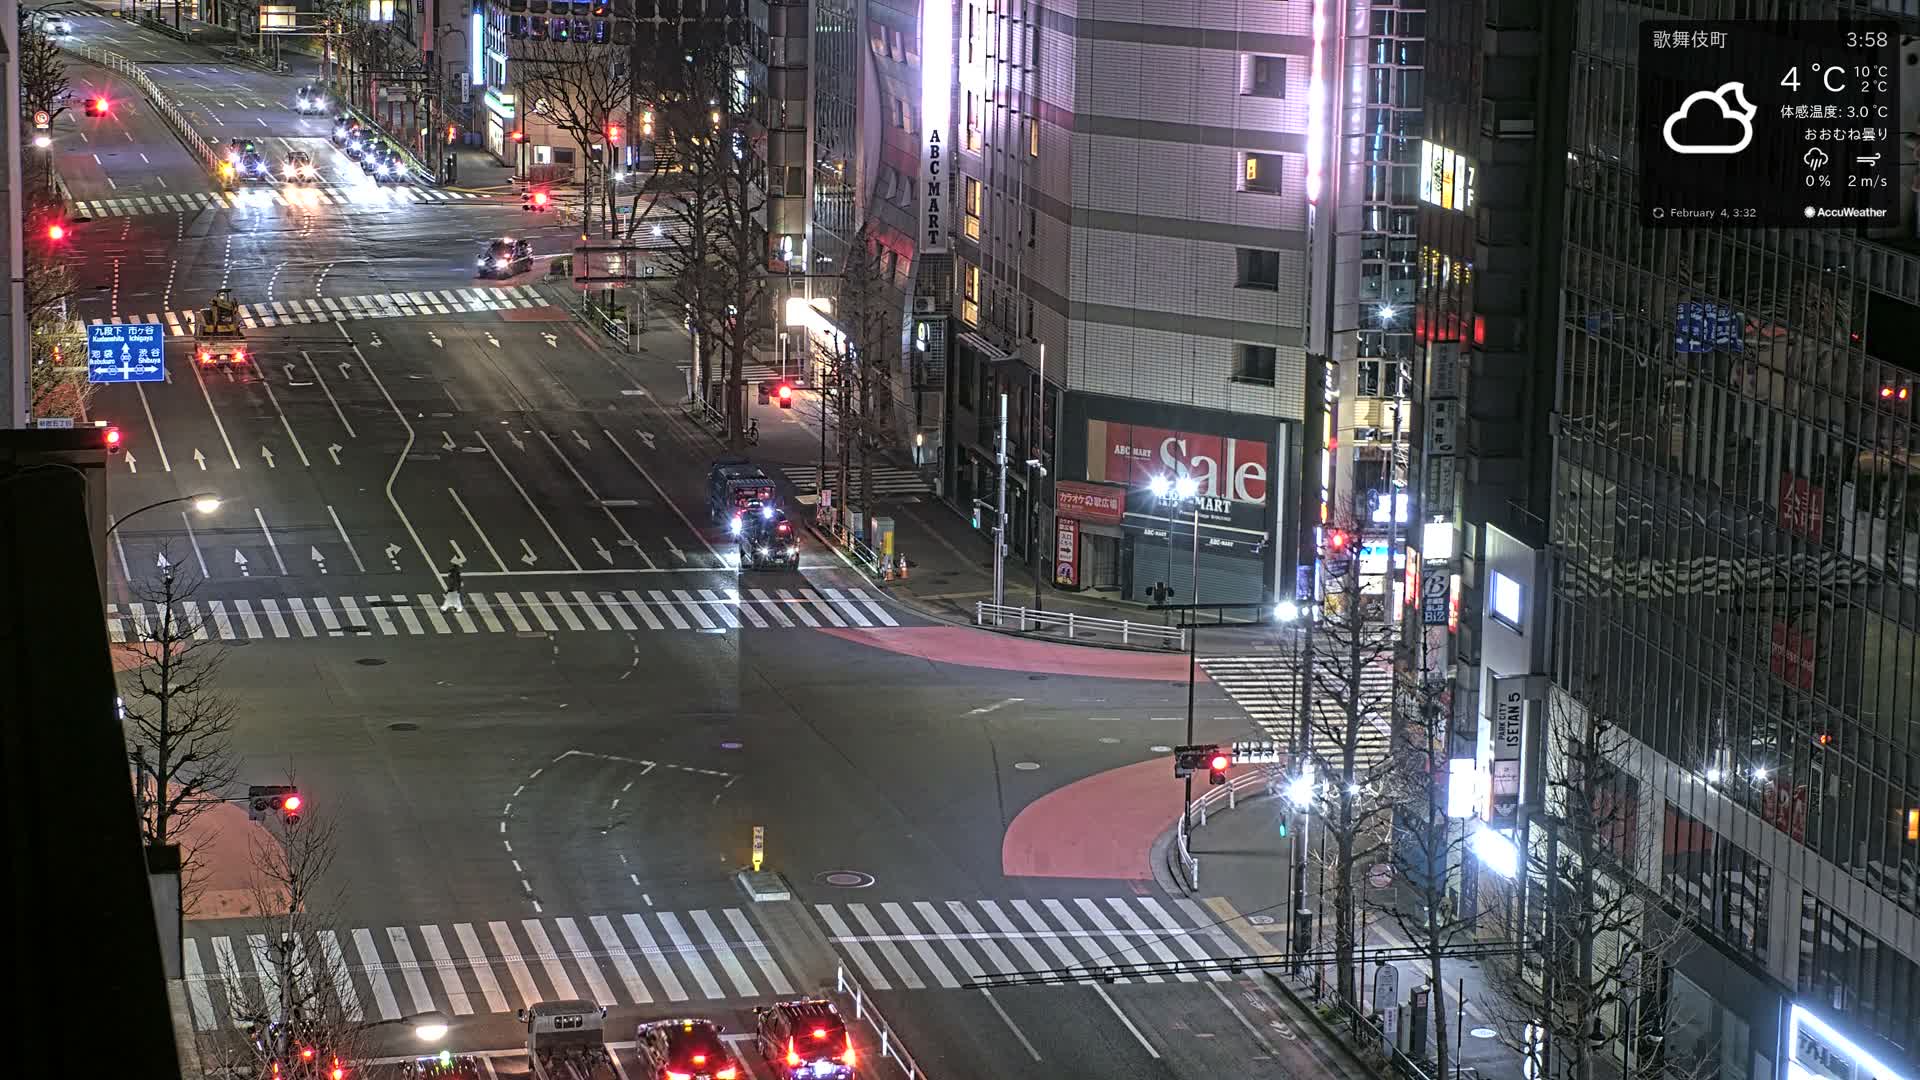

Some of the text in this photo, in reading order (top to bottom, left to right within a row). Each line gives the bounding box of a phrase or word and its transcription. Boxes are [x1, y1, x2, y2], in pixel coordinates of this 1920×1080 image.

[927, 129, 941, 245] ABC-MART
[95, 326, 122, 336] 九段下
[129, 335, 154, 343] Ichigaya
[138, 348, 161, 357] 渋谷
[138, 357, 161, 365] Shibuya
[1160, 436, 1266, 504] Sale
[1498, 702, 1507, 740] PARK CITY
[1506, 692, 1520, 747] ISETAN 5
